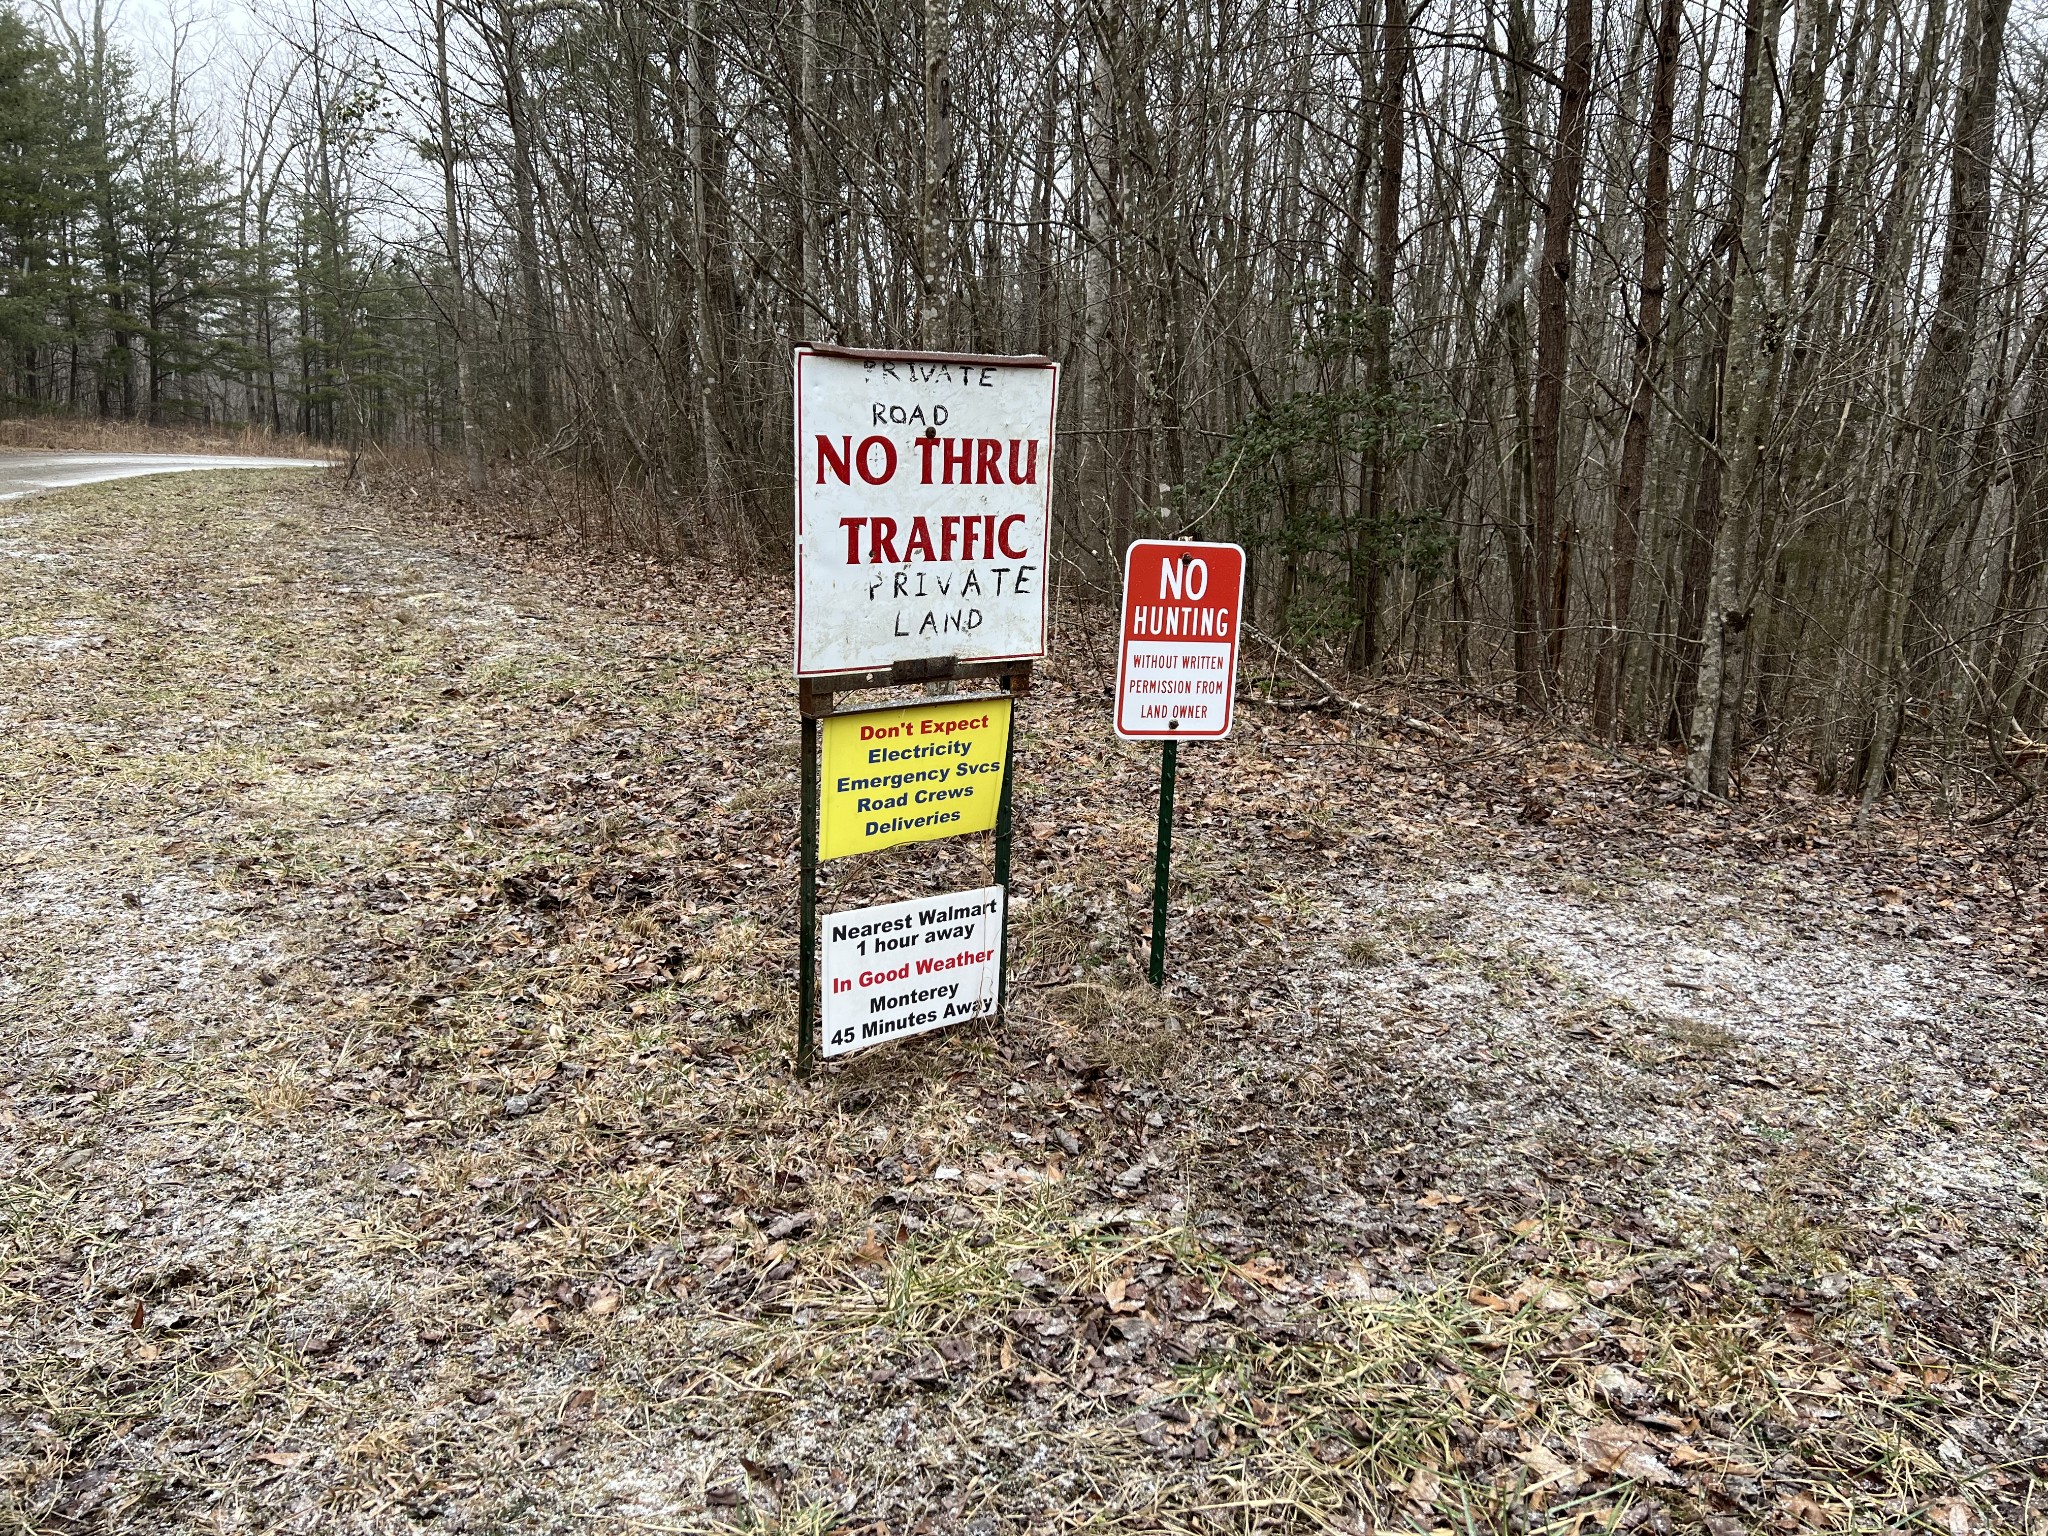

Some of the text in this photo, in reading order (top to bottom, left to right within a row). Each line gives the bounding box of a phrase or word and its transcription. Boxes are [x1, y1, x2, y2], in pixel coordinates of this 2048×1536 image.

[863, 360, 997, 387] PRIVATE
[872, 402, 949, 427] ROAD
[815, 435, 1040, 486] NO THRU
[838, 513, 1028, 565] TRAFFIC
[869, 565, 1038, 601] PRIVATE
[1159, 557, 1208, 601] NO
[894, 608, 983, 637] LAND
[1133, 605, 1229, 637] HUNTING
[1133, 654, 1224, 670] WITHOUT WRITTEN
[1129, 679, 1223, 695] PERMISSION FROM
[1140, 704, 1208, 719] LAND OWNER
[860, 715, 989, 741] Don't Expect
[868, 739, 972, 764] Electricity
[837, 761, 1000, 793] Emergency Svcs
[857, 785, 974, 813] Road Crews
[865, 809, 961, 836] Deliveries
[832, 899, 997, 942] Nearest Walmart
[857, 923, 975, 956] 1 hour away
[833, 949, 995, 994] In Good Weather
[870, 983, 960, 1014] Monterey
[831, 997, 993, 1046] 45 Minutes Away
